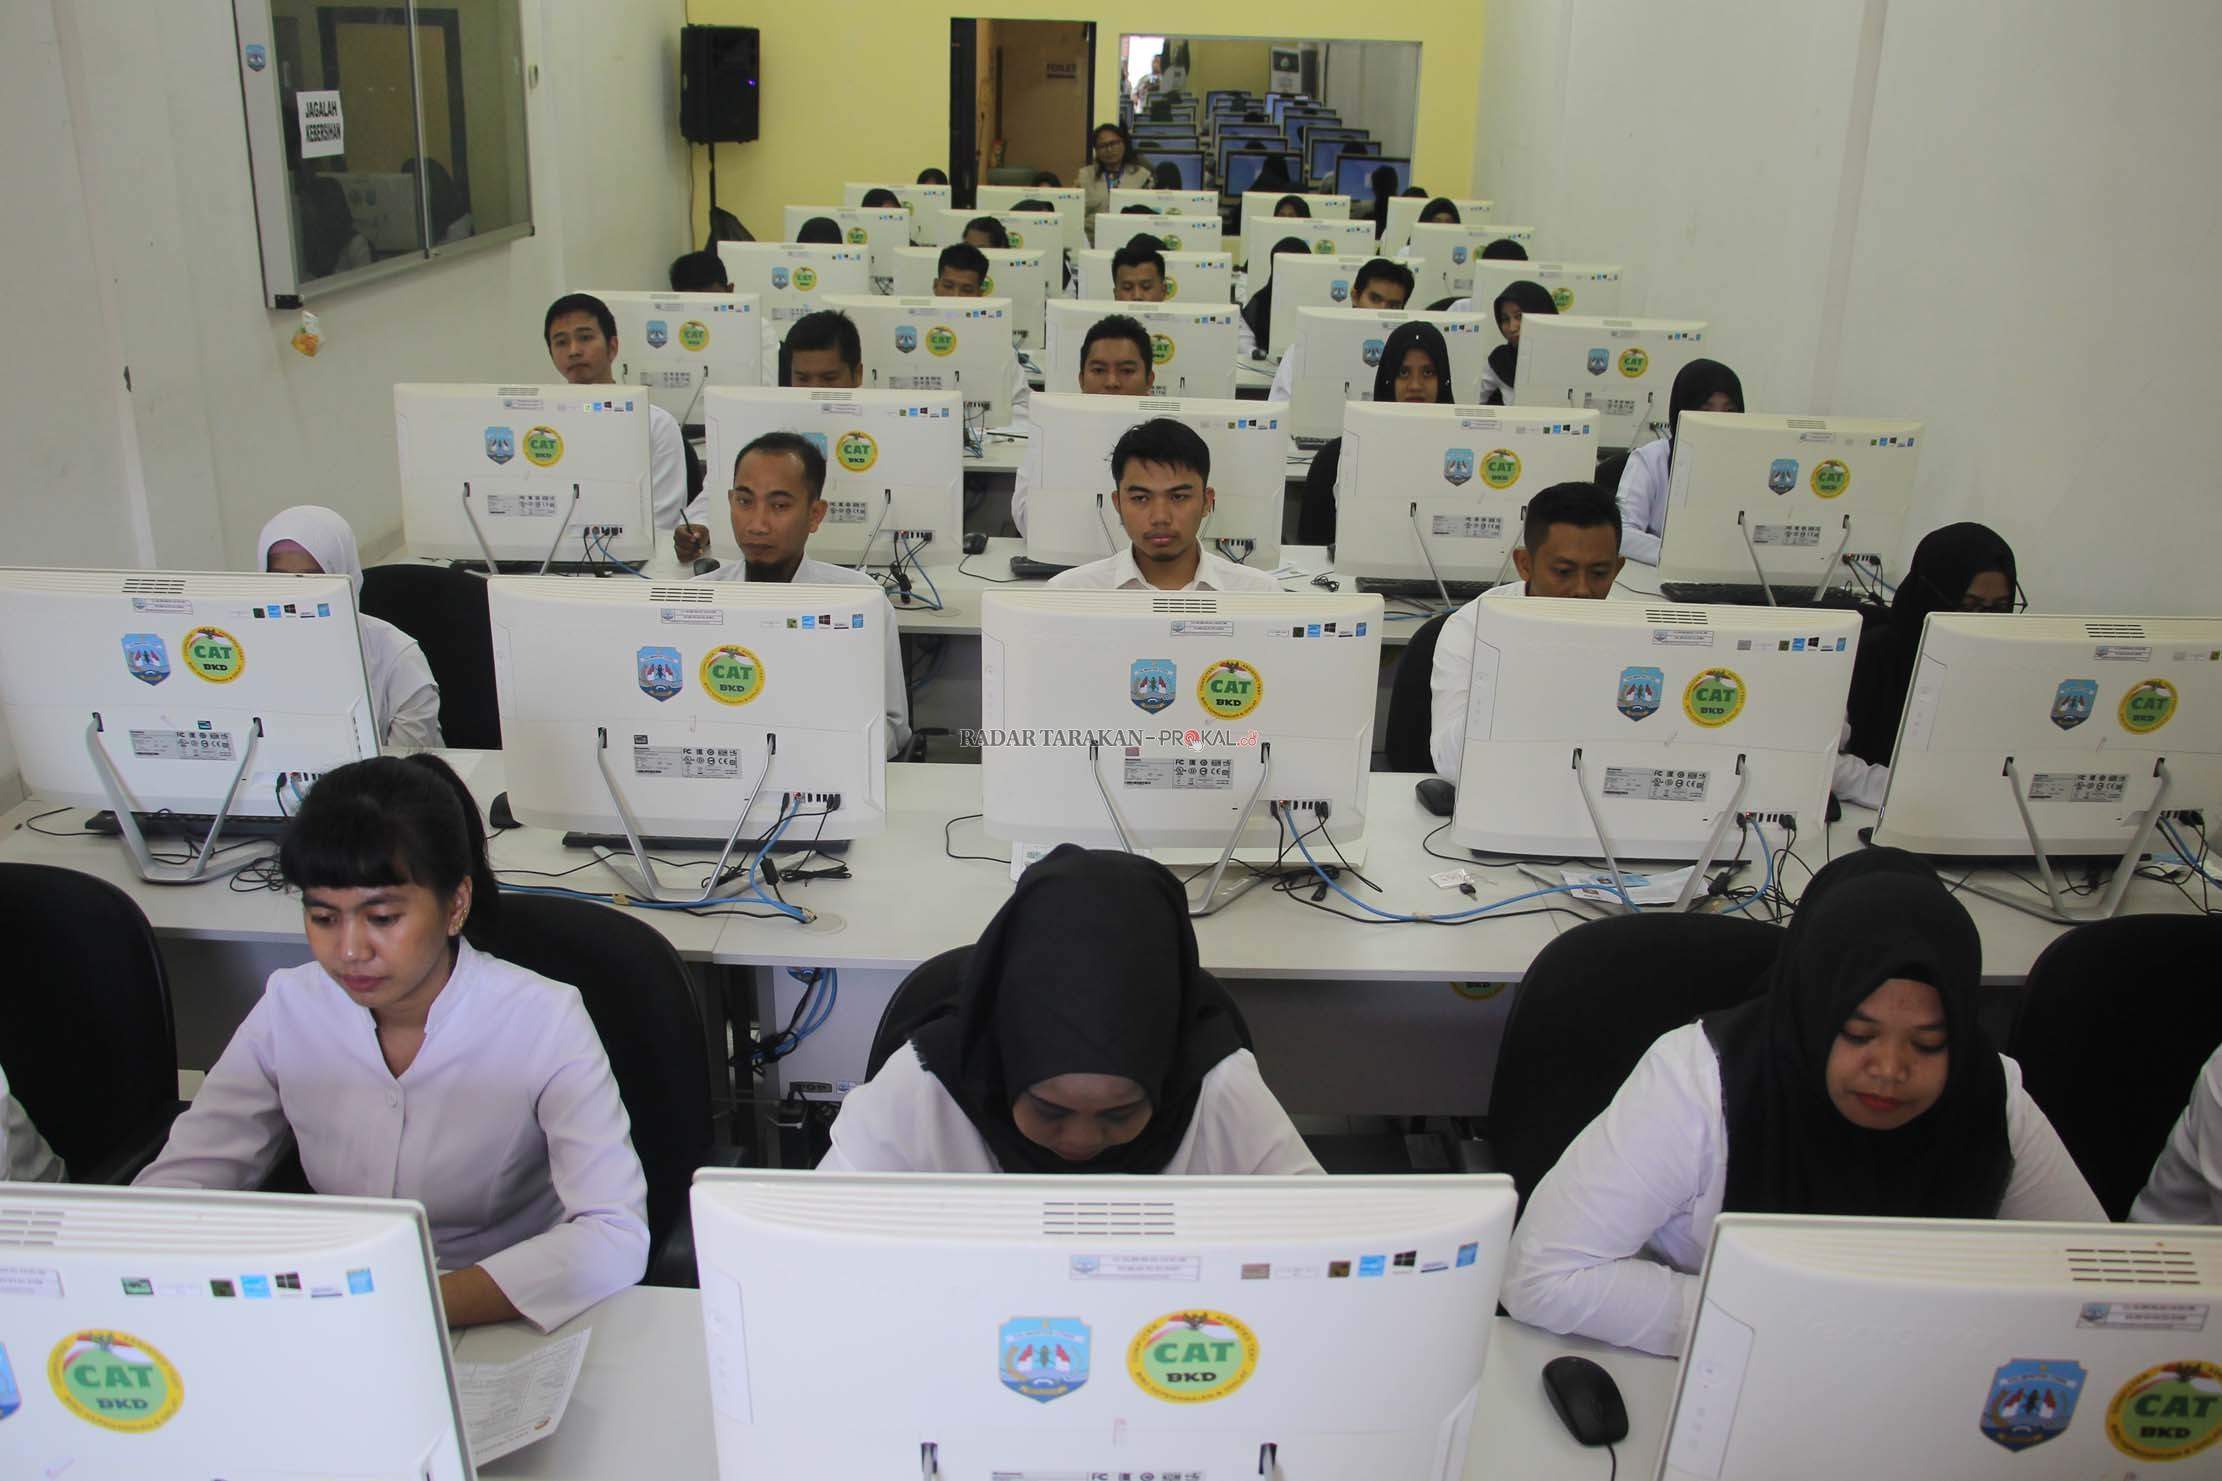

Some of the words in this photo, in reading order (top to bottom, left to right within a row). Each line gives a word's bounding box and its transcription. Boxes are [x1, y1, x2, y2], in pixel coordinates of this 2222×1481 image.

[305, 101, 338, 118] JAGALAH
[305, 124, 342, 143] KEBERSIHAN
[530, 439, 556, 450] CAT
[844, 444, 870, 455] CAT
[1488, 462, 1514, 472] CAT
[1818, 472, 1843, 482] CAT
[193, 645, 232, 660] CAT
[203, 663, 228, 672] BKD
[711, 665, 753, 681] CAT
[719, 684, 744, 693] BKD
[1210, 679, 1251, 694] CAT
[1696, 687, 1736, 703] CAT
[1215, 699, 1242, 707] BKD
[2131, 697, 2168, 711] CAT
[1700, 706, 1725, 715] BKD
[2132, 714, 2155, 722] BKD
[1153, 1342, 1236, 1364] CAT
[73, 1364, 153, 1388] CAT
[1166, 1372, 1217, 1382] BKD
[96, 1396, 148, 1411] BKD
[2134, 1394, 2220, 1418] CAT
[2140, 1426, 2192, 1438] BKD
